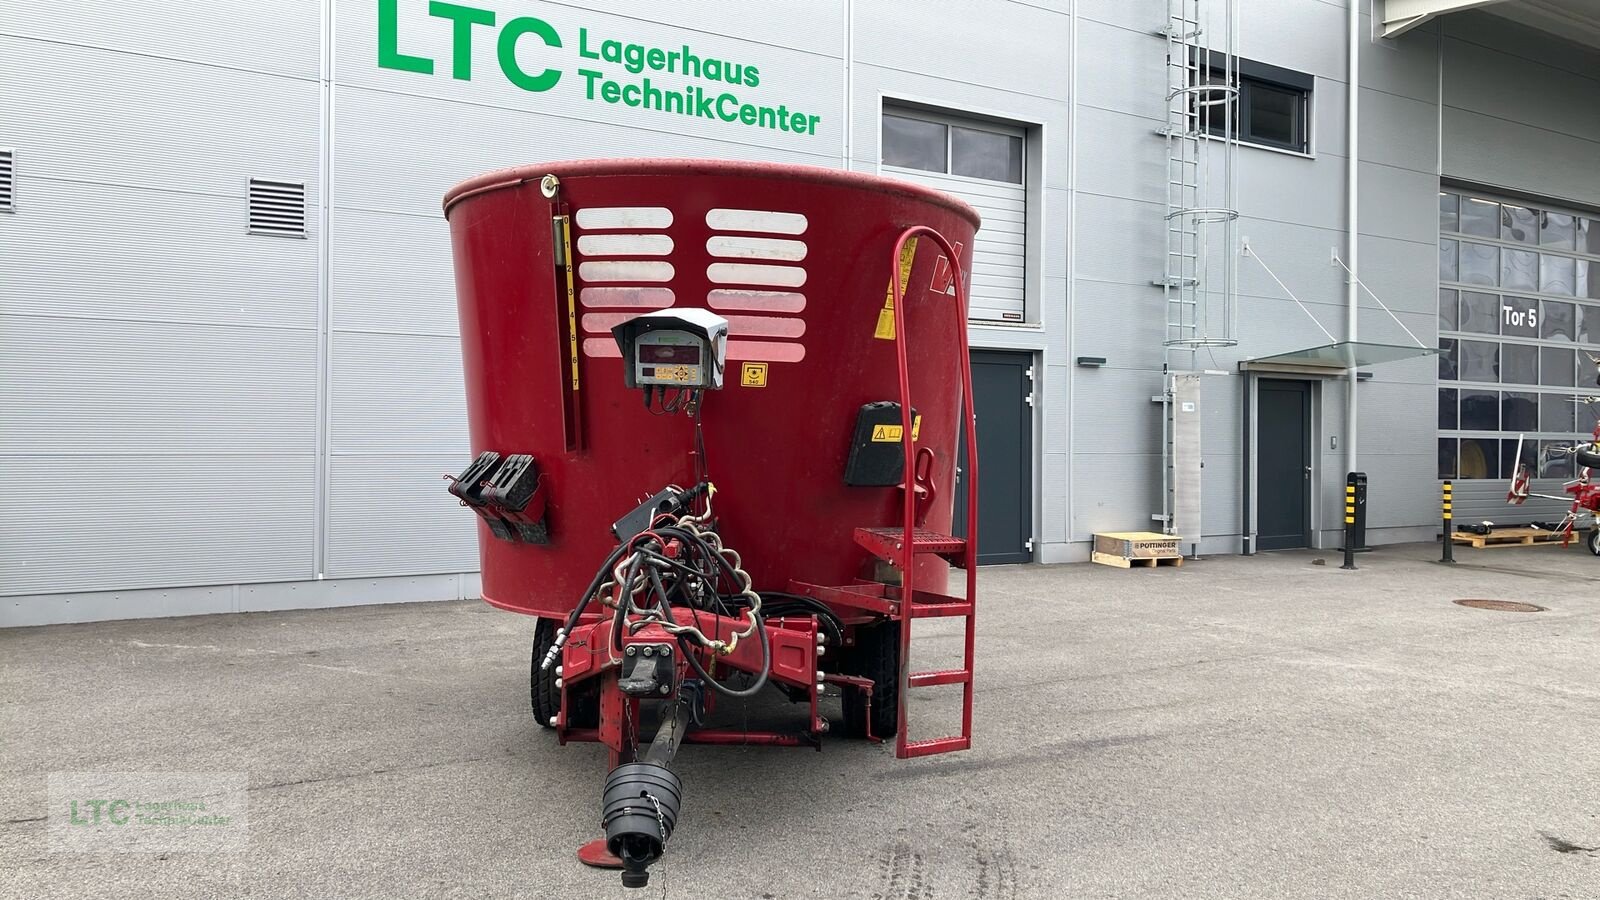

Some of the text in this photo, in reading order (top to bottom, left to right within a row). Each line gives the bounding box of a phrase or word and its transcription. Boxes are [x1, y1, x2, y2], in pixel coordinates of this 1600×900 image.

[378, 0, 563, 92] LTC
[579, 27, 760, 88] Lagerhaus
[578, 68, 820, 135] TechnikCenter
[563, 216, 569, 225] 0
[566, 265, 572, 273] 2
[568, 288, 574, 296] 3
[1503, 305, 1537, 328] Tor 5
[571, 334, 576, 342] 5
[572, 356, 577, 364] 6
